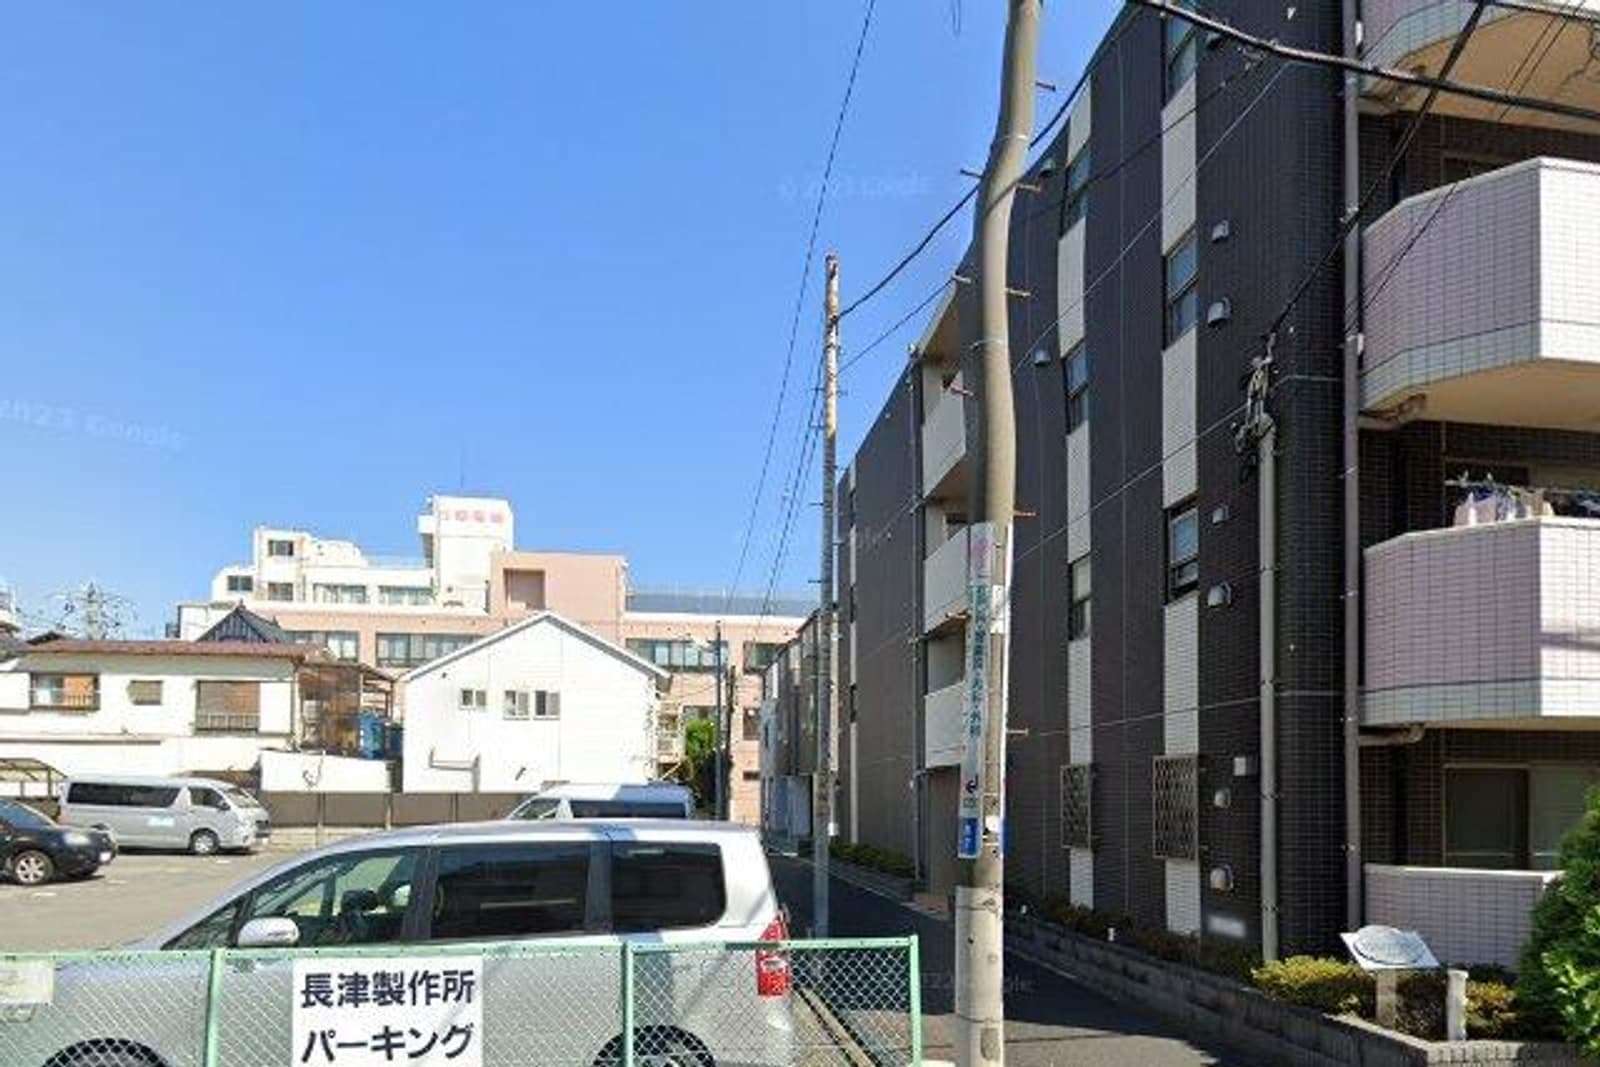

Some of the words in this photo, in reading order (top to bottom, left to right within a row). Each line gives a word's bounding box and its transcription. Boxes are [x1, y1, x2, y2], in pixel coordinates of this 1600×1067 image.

[301, 969, 475, 1008] 長津製作所
[301, 1022, 475, 1063] パーキング
